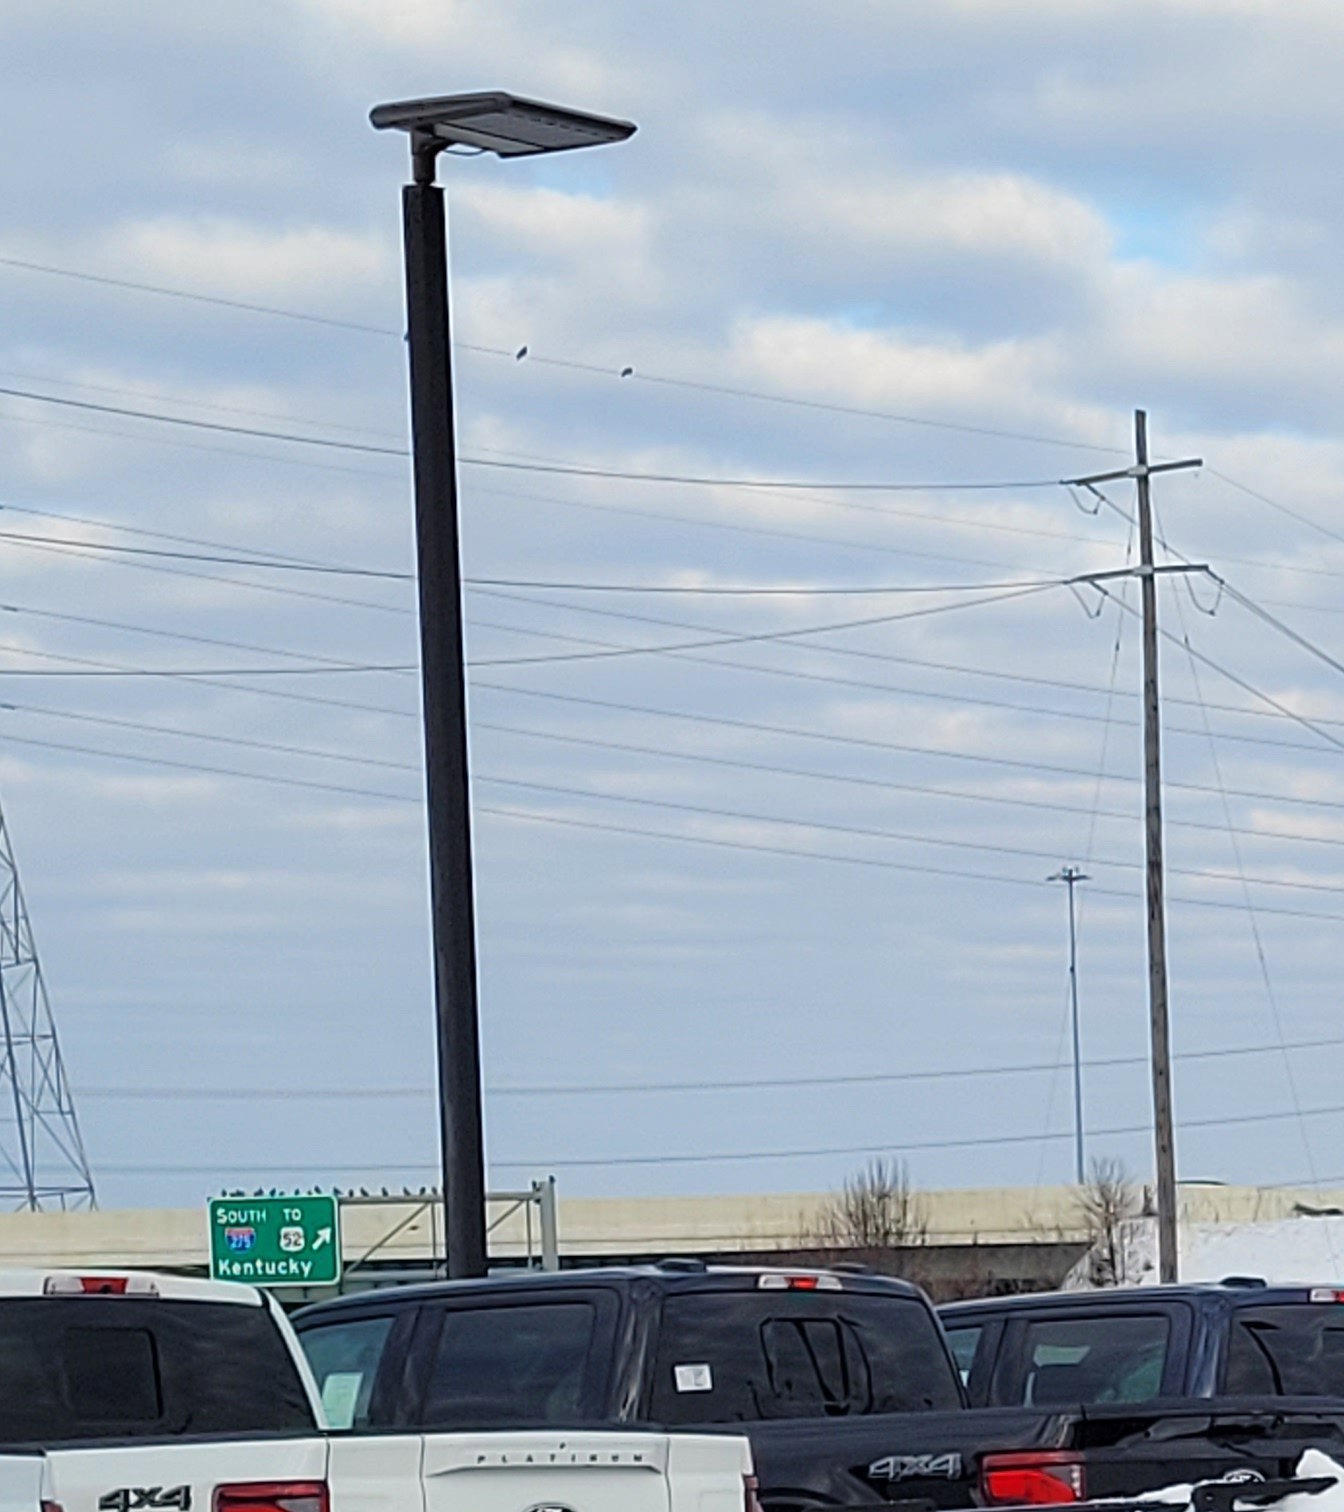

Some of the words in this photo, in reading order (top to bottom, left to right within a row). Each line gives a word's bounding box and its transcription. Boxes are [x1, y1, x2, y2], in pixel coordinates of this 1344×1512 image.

[216, 1207, 267, 1224] SOUTH
[282, 1208, 302, 1222] TO
[282, 1231, 302, 1247] 52
[218, 1257, 313, 1278] Kentucky
[476, 1453, 643, 1464] PLATINUM
